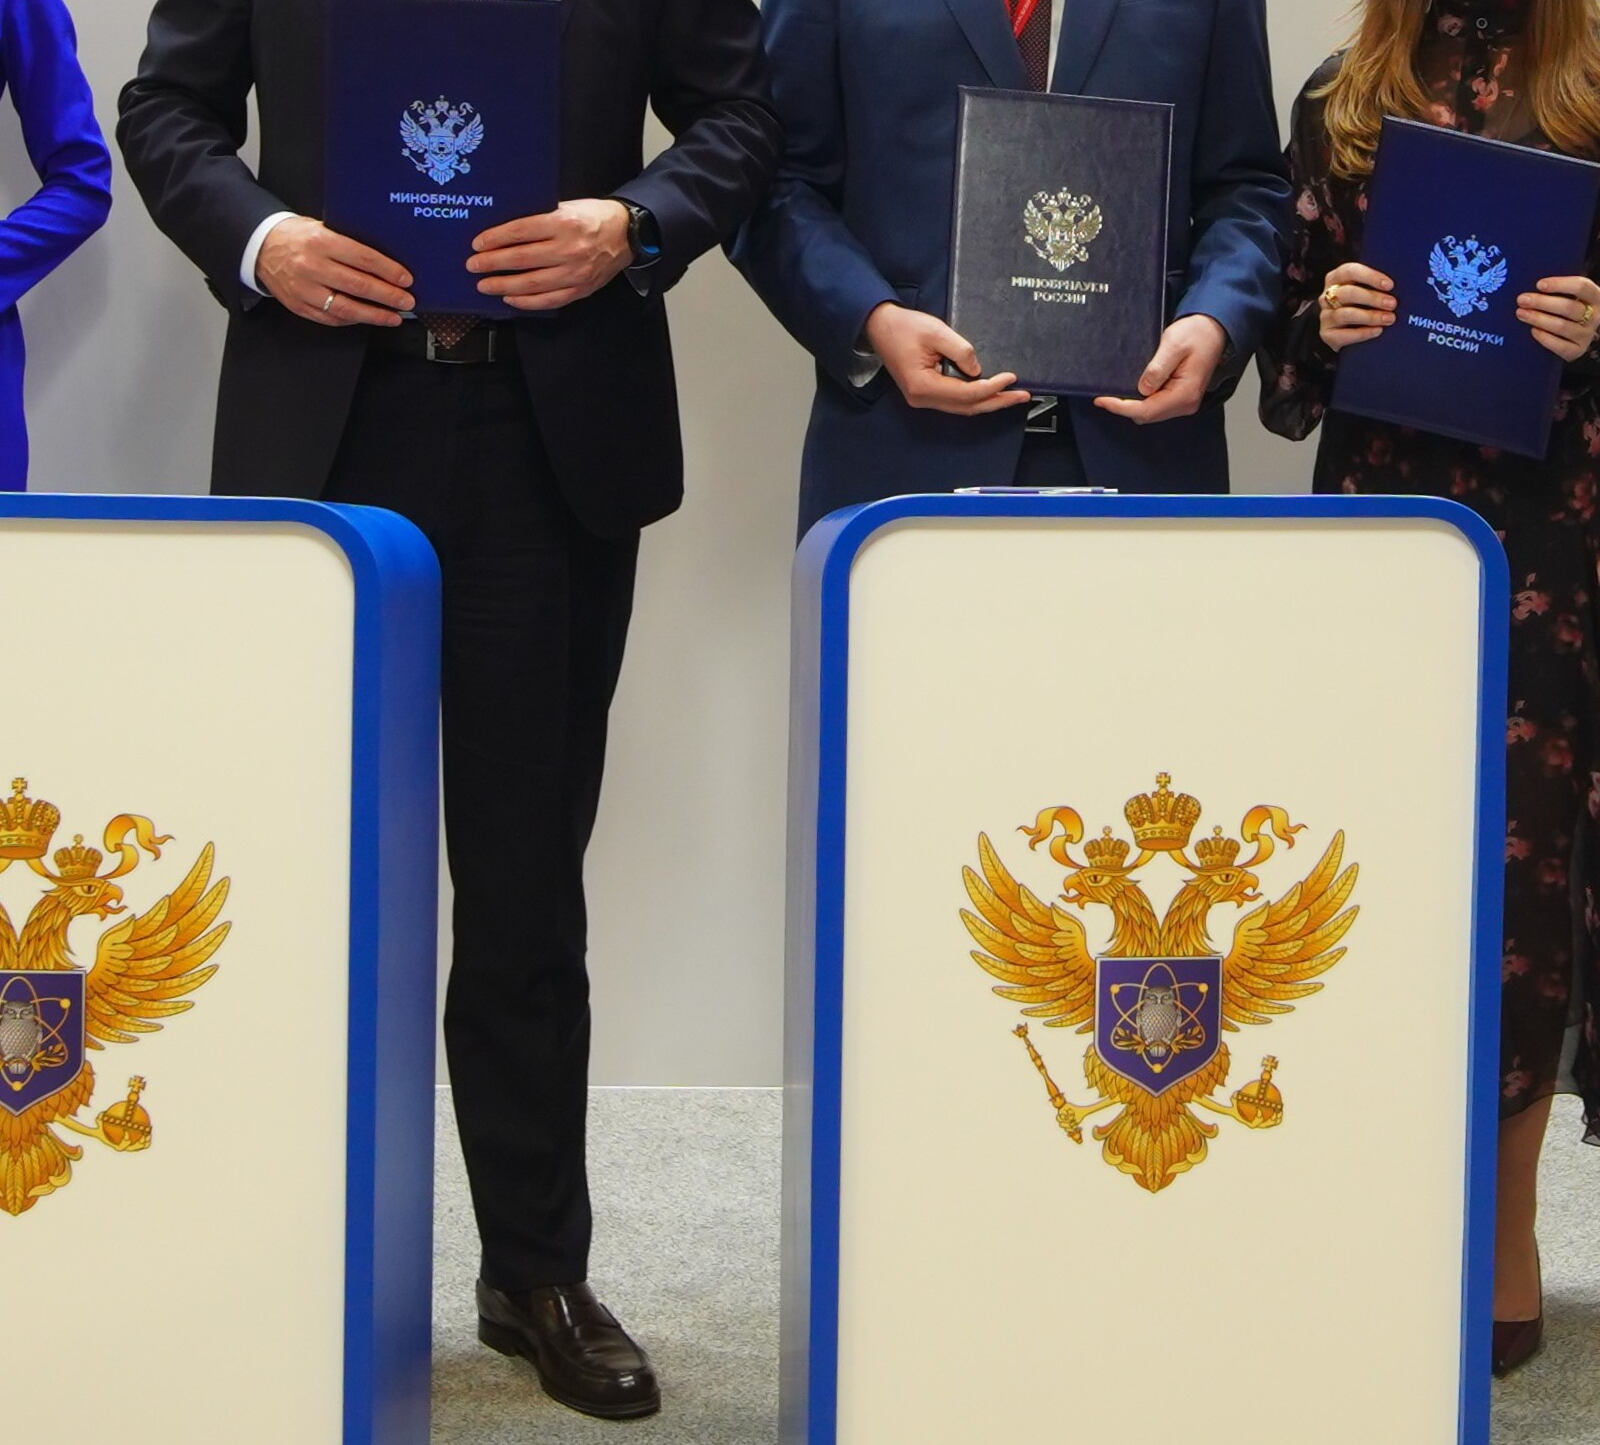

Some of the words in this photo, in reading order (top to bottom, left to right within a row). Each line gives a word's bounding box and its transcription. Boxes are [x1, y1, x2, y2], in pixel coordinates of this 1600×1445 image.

[389, 192, 493, 207] МИНОБРНАУКИ
[413, 207, 469, 219] РОССИИ
[1011, 276, 1109, 293] МИНОБРНАУКИ
[1033, 292, 1086, 304] РОССИИ
[1408, 314, 1504, 346] МИНОБРНАУКИ
[1428, 332, 1480, 353] РОССИИ
